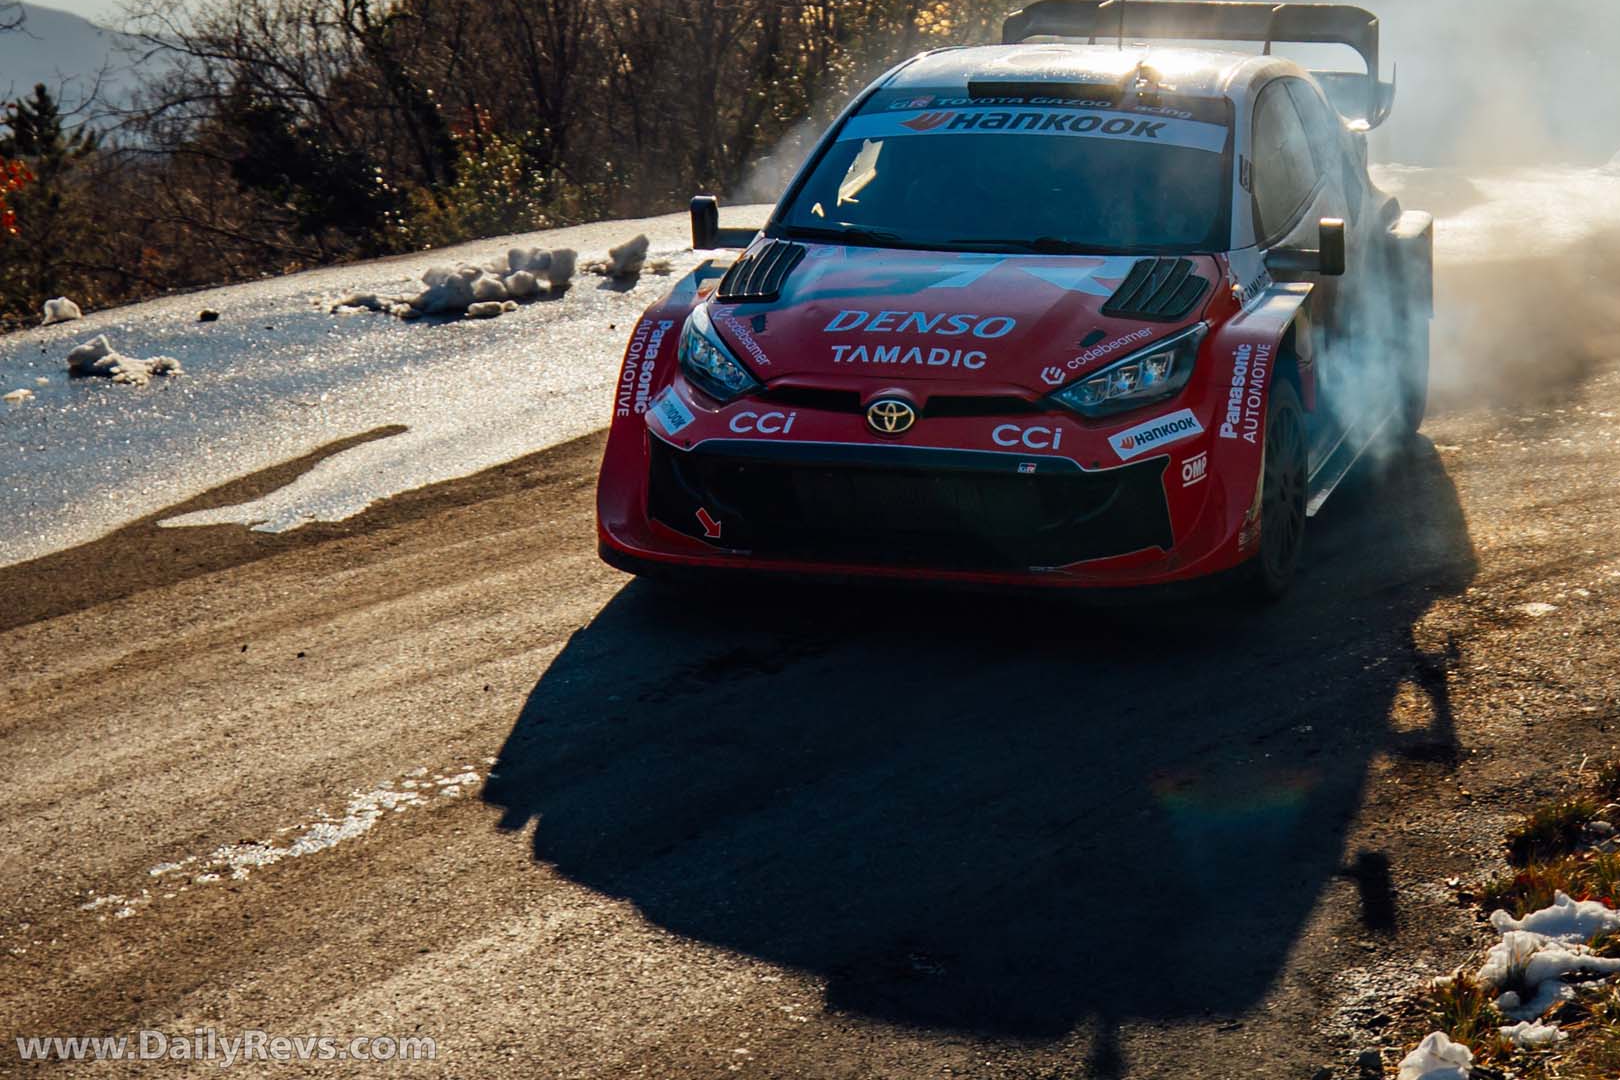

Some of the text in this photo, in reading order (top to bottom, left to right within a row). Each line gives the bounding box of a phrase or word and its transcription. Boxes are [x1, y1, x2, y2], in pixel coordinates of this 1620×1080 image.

[937, 96, 1025, 106] TOYOTA
[1029, 96, 1112, 108] GAZOO
[724, 314, 770, 366] codebeamer
[824, 310, 1017, 339] DENSO
[831, 345, 988, 370] TAMADIC
[1067, 327, 1153, 369] codebeamer
[617, 319, 653, 417] AUTOMOTIVE
[634, 320, 673, 414] Panasonic
[1219, 343, 1253, 439] Panasonic
[1243, 343, 1272, 444] AUTOMOTIVE
[729, 411, 797, 434] CCi
[991, 423, 1063, 450] CCi
[1182, 456, 1208, 481] OMP
